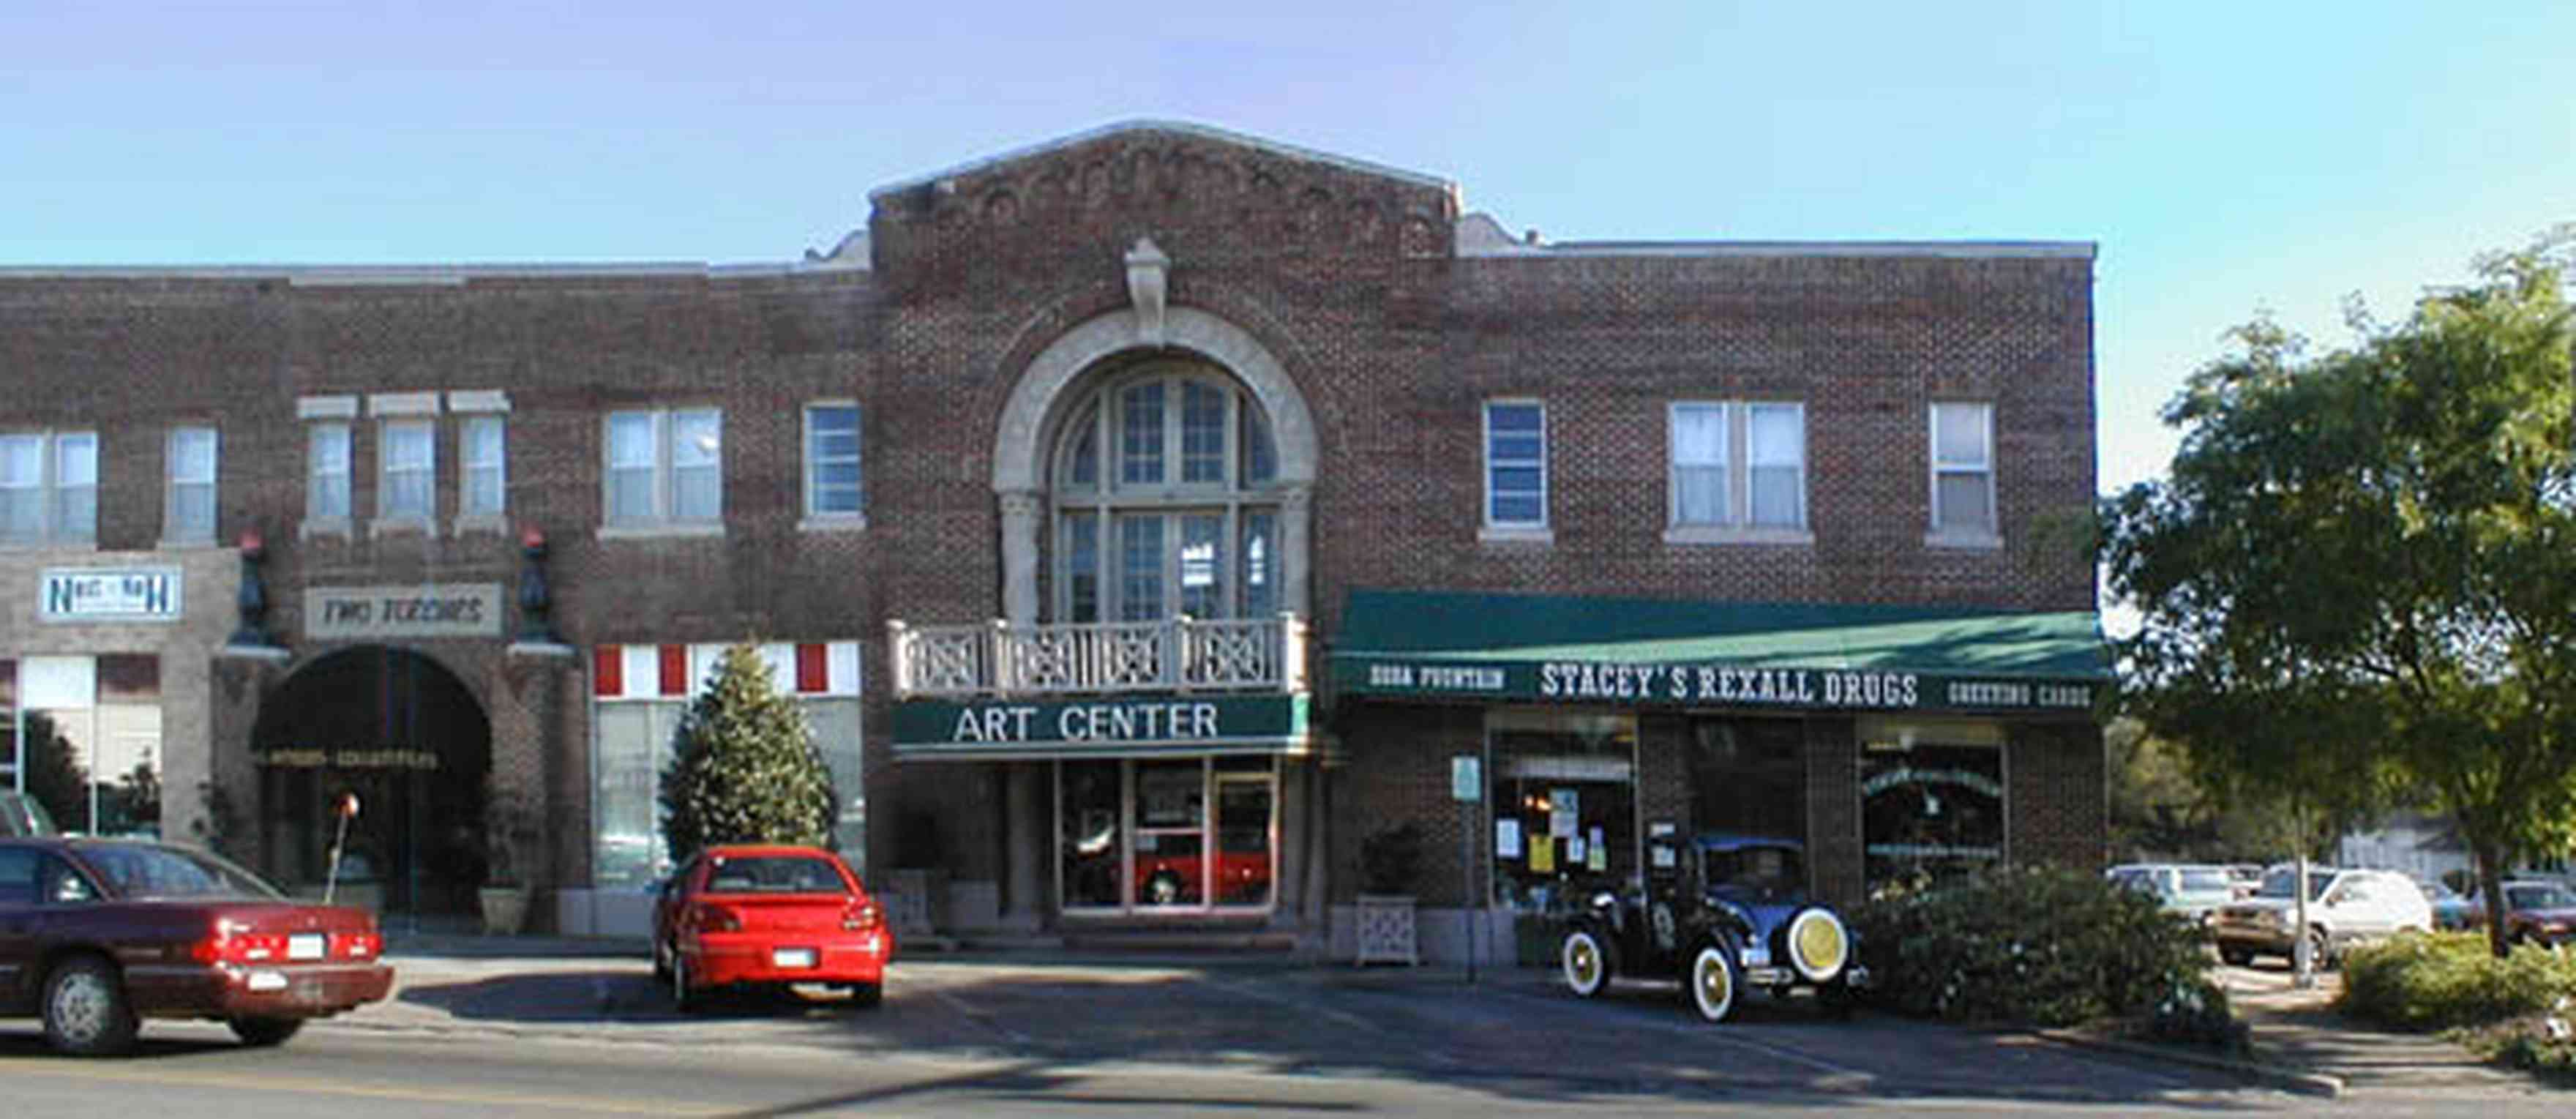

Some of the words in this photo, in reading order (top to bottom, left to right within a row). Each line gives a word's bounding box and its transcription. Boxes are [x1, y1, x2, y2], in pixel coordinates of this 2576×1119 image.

[1541, 662, 1688, 699] STACEY'S
[1698, 667, 1814, 703] REXALL
[1825, 670, 1918, 707] DRUGS
[953, 706, 1038, 741] ART
[1060, 703, 1218, 739] CENTER
